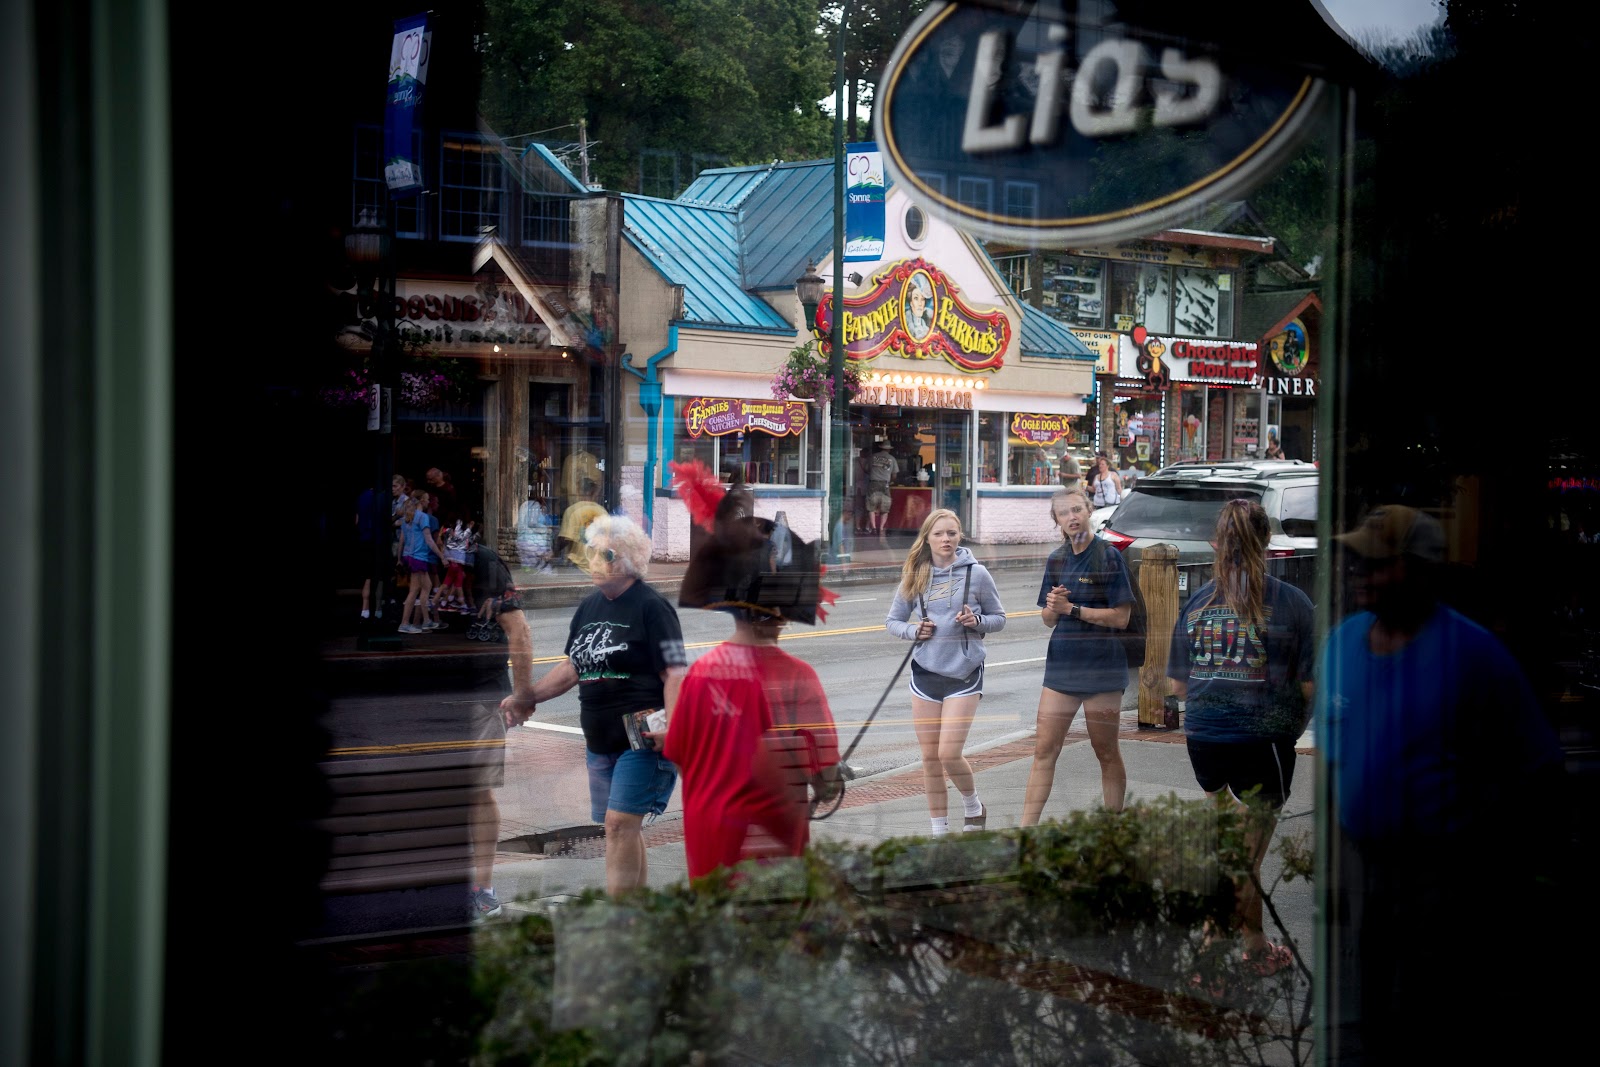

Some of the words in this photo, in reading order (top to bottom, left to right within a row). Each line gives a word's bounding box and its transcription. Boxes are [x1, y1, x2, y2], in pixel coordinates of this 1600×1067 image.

[1172, 341, 1258, 363] Chocolate
[1188, 361, 1257, 382] Monkey
[886, 384, 915, 407] FUN
[918, 386, 973, 409] PARLOR
[690, 402, 730, 431] FANNIE'S
[709, 413, 737, 426] CORNER
[711, 419, 741, 432] KITCHEN
[748, 415, 787, 432] CHEESESTEAK
[1021, 419, 1041, 431] OGLE
[1041, 420, 1061, 431] DOGS
